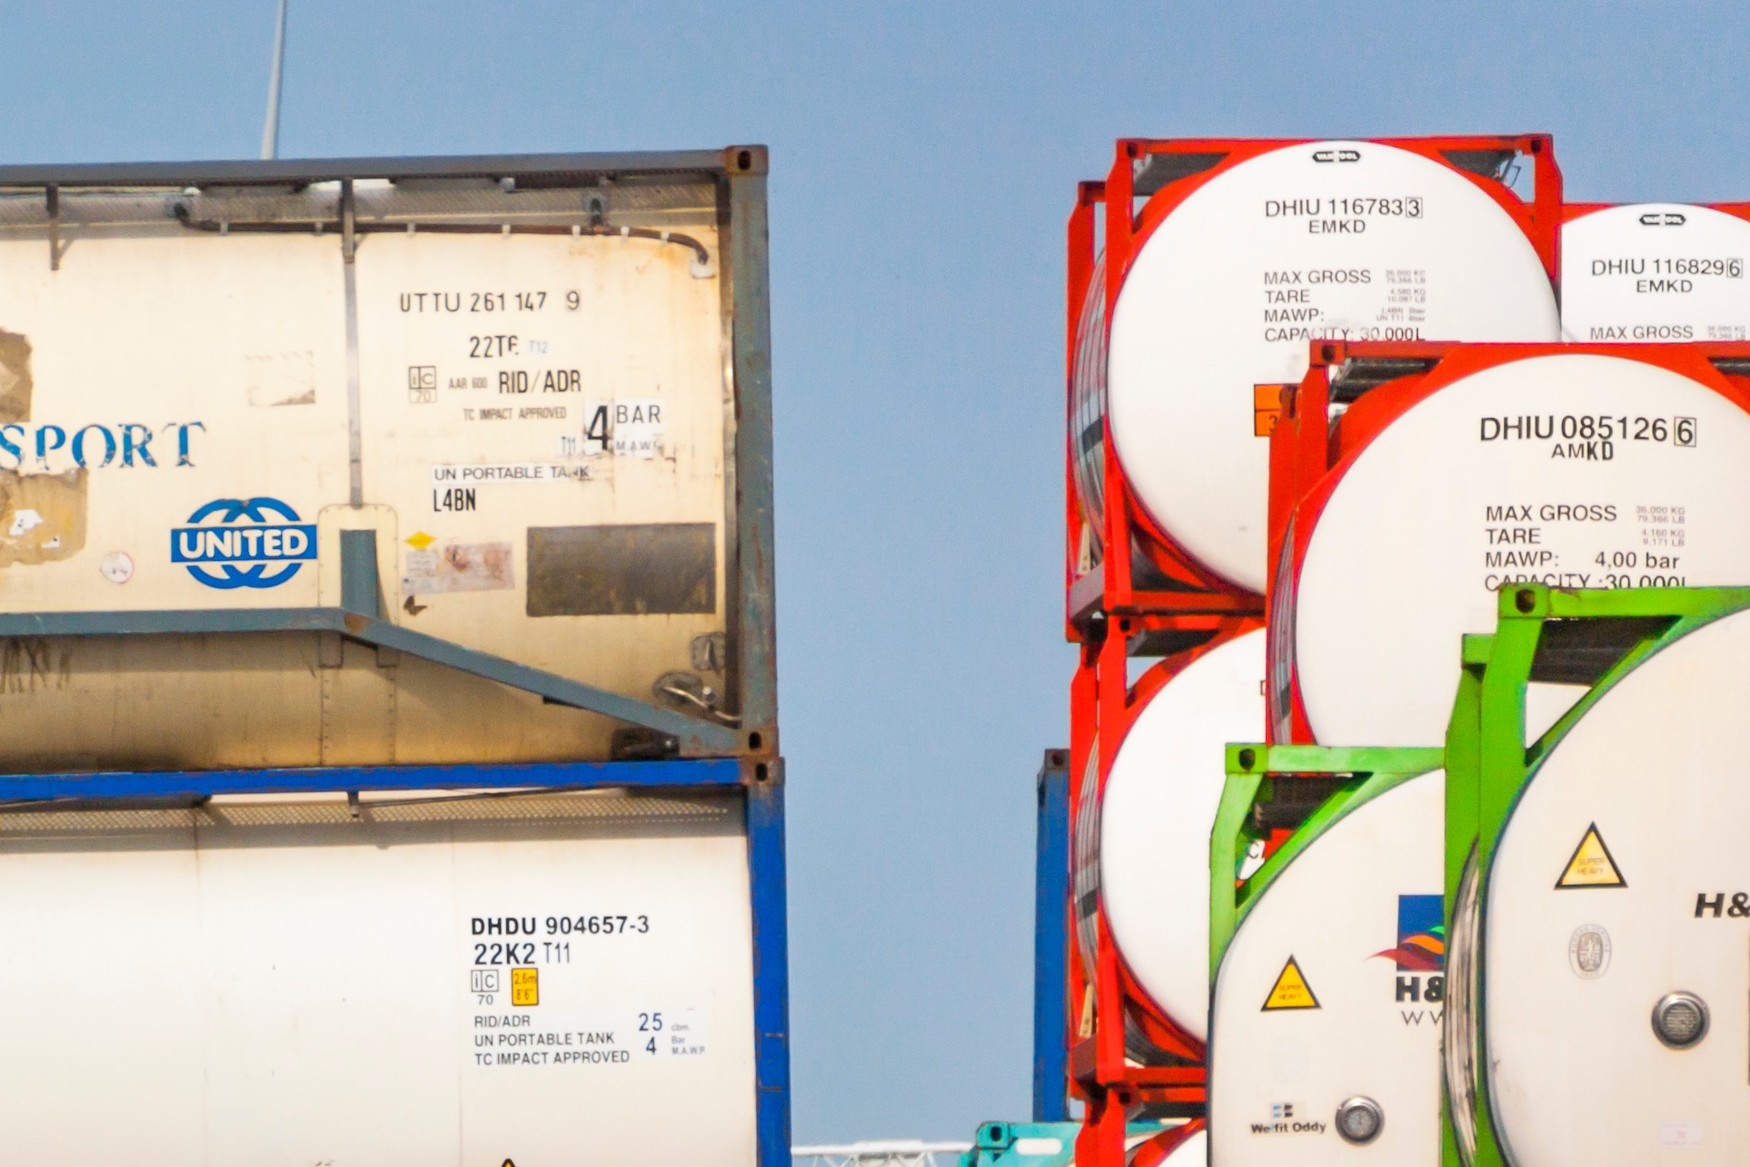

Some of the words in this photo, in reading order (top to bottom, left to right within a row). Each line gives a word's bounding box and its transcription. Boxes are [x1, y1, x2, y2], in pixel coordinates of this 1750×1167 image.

[1265, 198, 1320, 217] DHIU
[1329, 198, 1403, 216] 116783
[1407, 199, 1421, 218] 3
[1308, 219, 1366, 234] EMKD
[1264, 270, 1302, 285] MAX
[1308, 269, 1371, 284] GROSS
[1592, 258, 1645, 276] DHIU
[1653, 258, 1724, 275] 116829
[1729, 260, 1740, 277] 6
[1636, 279, 1693, 293] EMKD
[400, 292, 461, 313] UTTU
[470, 292, 506, 312] 261
[514, 291, 547, 311] 147
[566, 290, 580, 311] 9
[1265, 289, 1310, 304] TARE
[1264, 308, 1324, 323] MAWP:
[1590, 326, 1627, 340] MAX
[1633, 325, 1693, 339] GROSS
[499, 370, 581, 393] RID/ADR
[479, 407, 513, 420] IMPACT
[519, 406, 567, 419] APPROVED
[587, 404, 612, 451] 4
[616, 404, 661, 424] BAR
[1480, 415, 1554, 442] DHIU
[1561, 415, 1668, 442] 085126
[1677, 419, 1693, 445] 6
[1551, 440, 1614, 460] AMKD
[434, 468, 456, 480] UN
[463, 466, 543, 480] PORTABLE
[433, 488, 476, 512] L4BN
[1486, 505, 1532, 522] MAX
[1540, 504, 1617, 522] GROSS
[179, 528, 308, 559] UNITED
[1485, 528, 1541, 545] TARE
[1485, 551, 1560, 568] MAWP:
[1595, 551, 1637, 571] 4,00
[1645, 551, 1680, 569] bar
[471, 917, 537, 935] DHDU
[546, 915, 649, 934] 904657-3
[474, 943, 536, 965] 22K2
[543, 942, 570, 964] T11
[477, 994, 494, 1005] 70
[474, 1015, 530, 1028] RID/ADR
[638, 1012, 663, 1032] 25
[474, 1034, 493, 1047] UN
[499, 1033, 572, 1047] PORTABLE
[578, 1032, 615, 1045] TANK
[645, 1036, 657, 1056] 4
[475, 1053, 492, 1066] TC
[497, 1052, 548, 1066] IMPACT
[553, 1050, 630, 1064] APPROVED
[1292, 1121, 1327, 1134] Oddy
